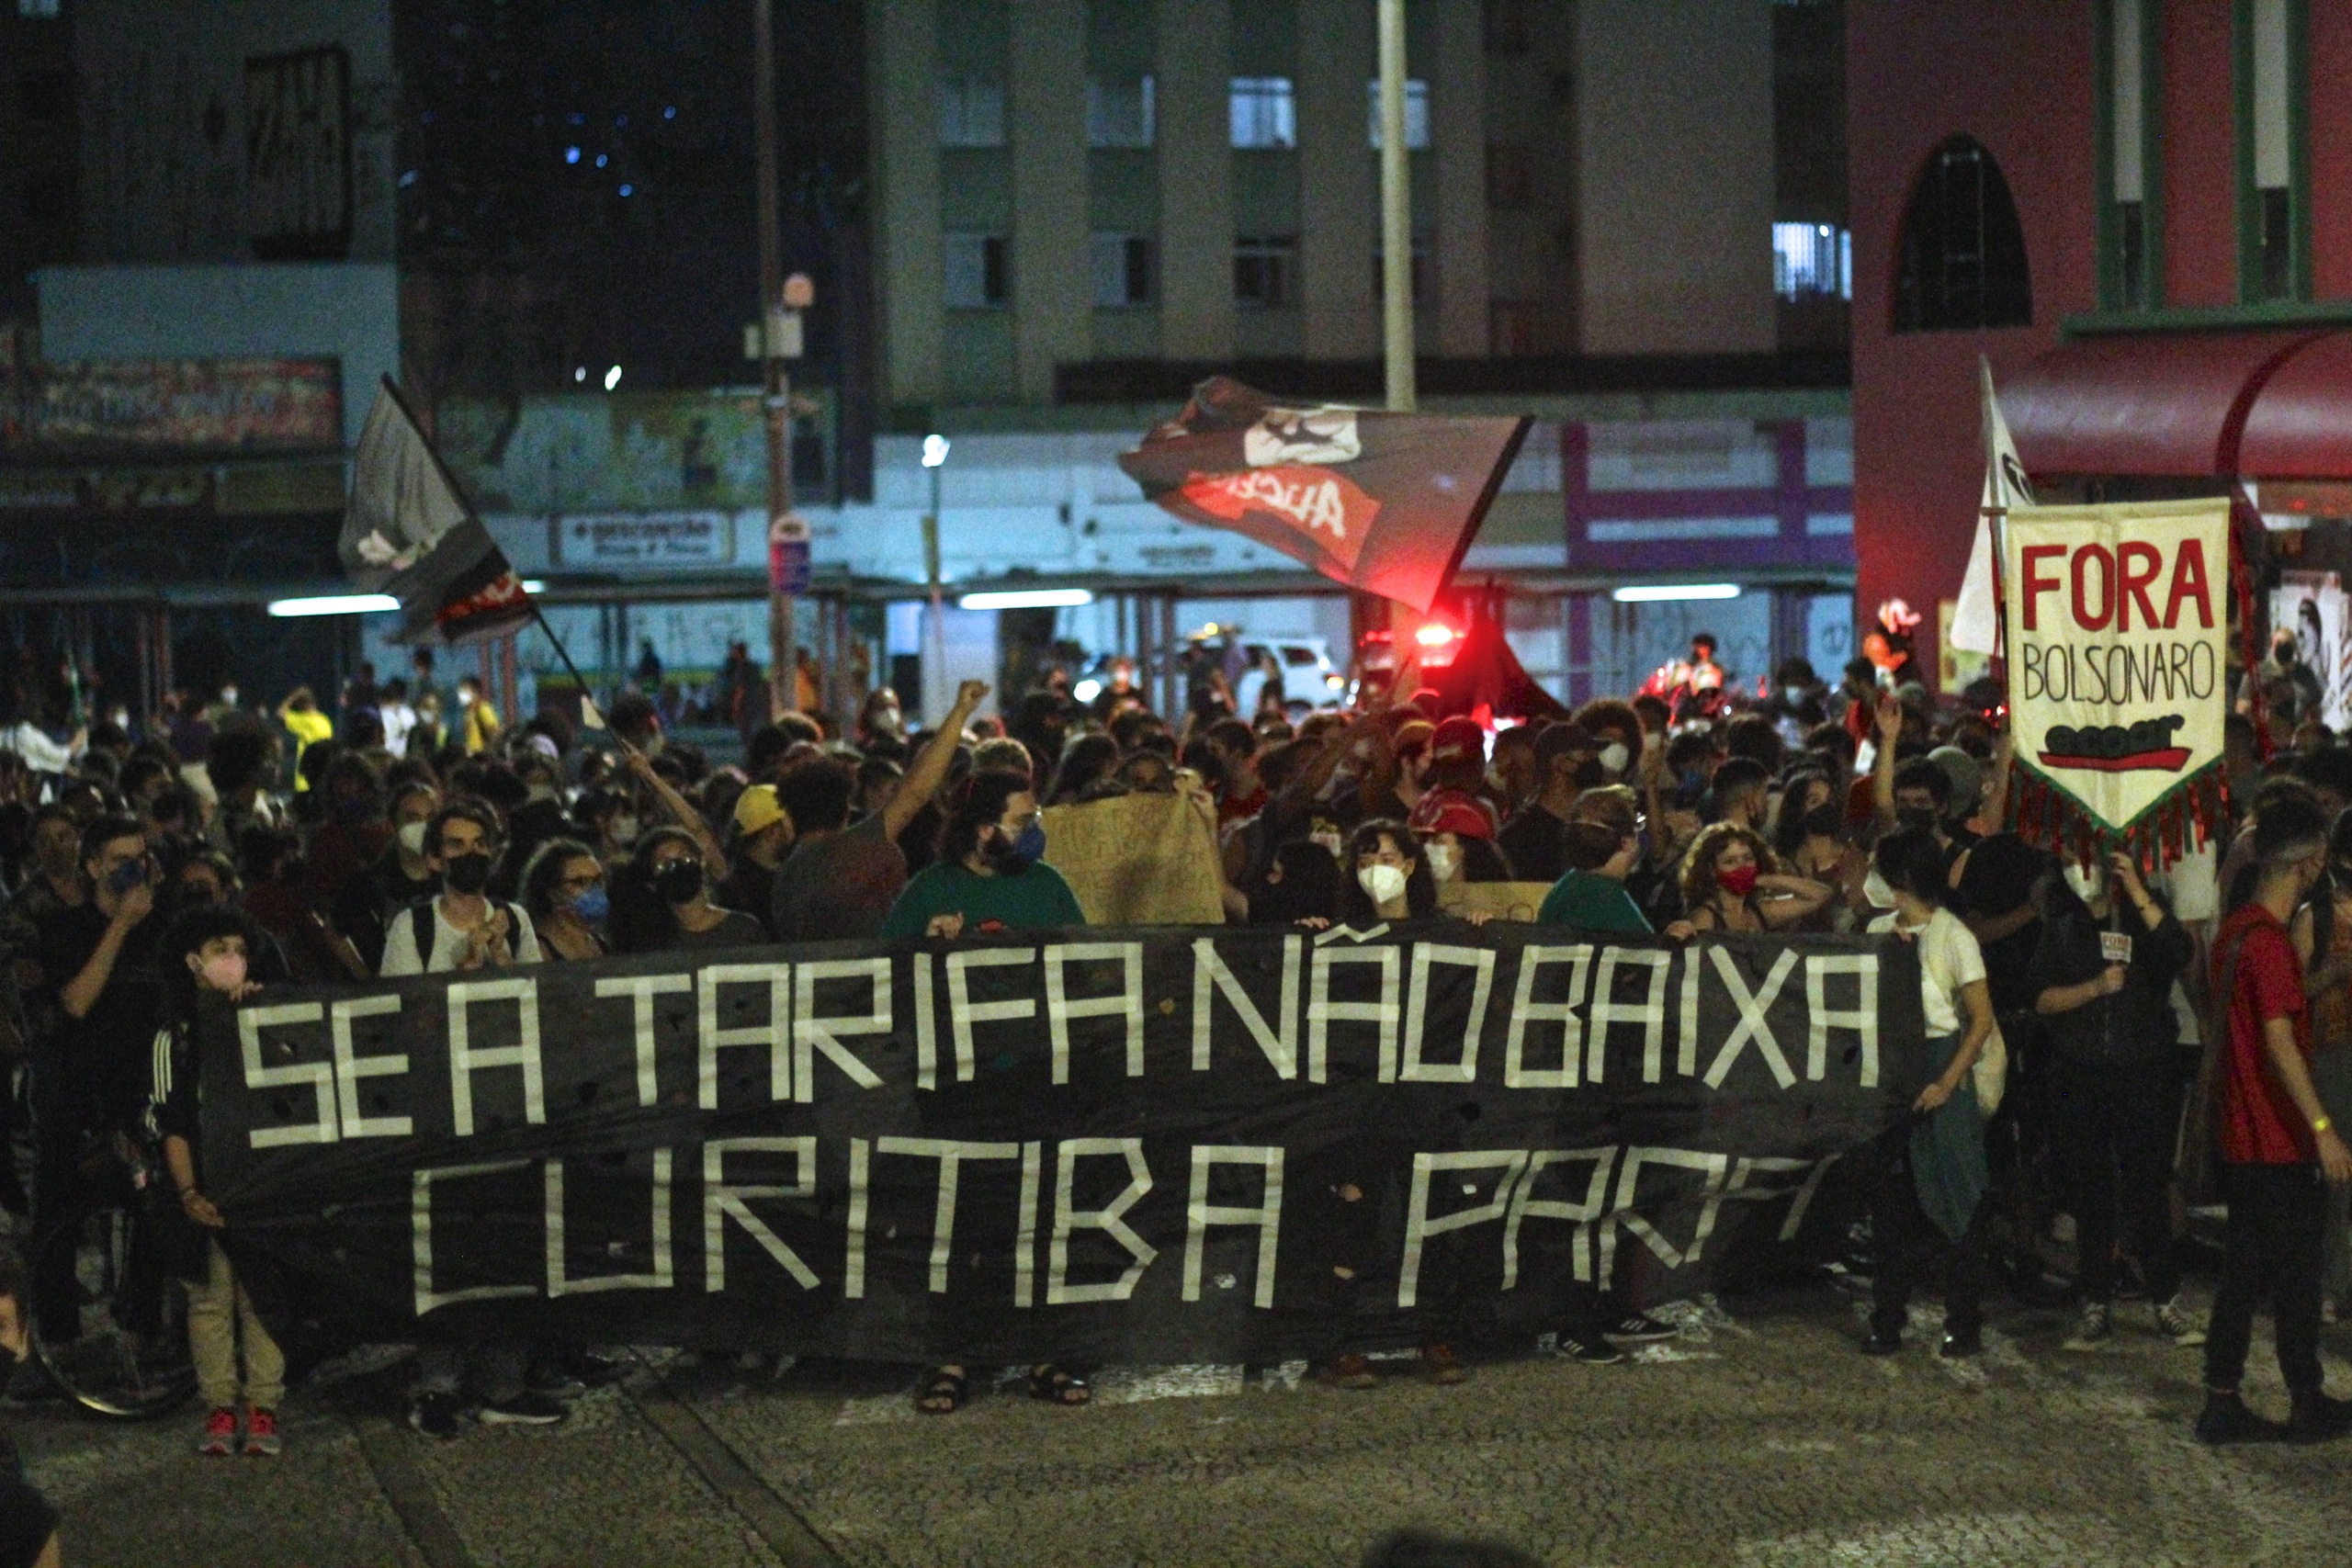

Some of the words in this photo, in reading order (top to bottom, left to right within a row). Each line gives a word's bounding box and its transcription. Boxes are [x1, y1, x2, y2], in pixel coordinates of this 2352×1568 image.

[2021, 538, 2214, 633] FORA
[2023, 640, 2215, 705] BOLSONARO
[238, 995, 413, 1149] SE
[447, 977, 546, 1135] A
[594, 942, 1144, 1110] TARIFA
[1192, 922, 1496, 1084] NÃO
[1505, 943, 1879, 1089] BAIXA
[413, 1135, 1284, 1316] CURITIBA
